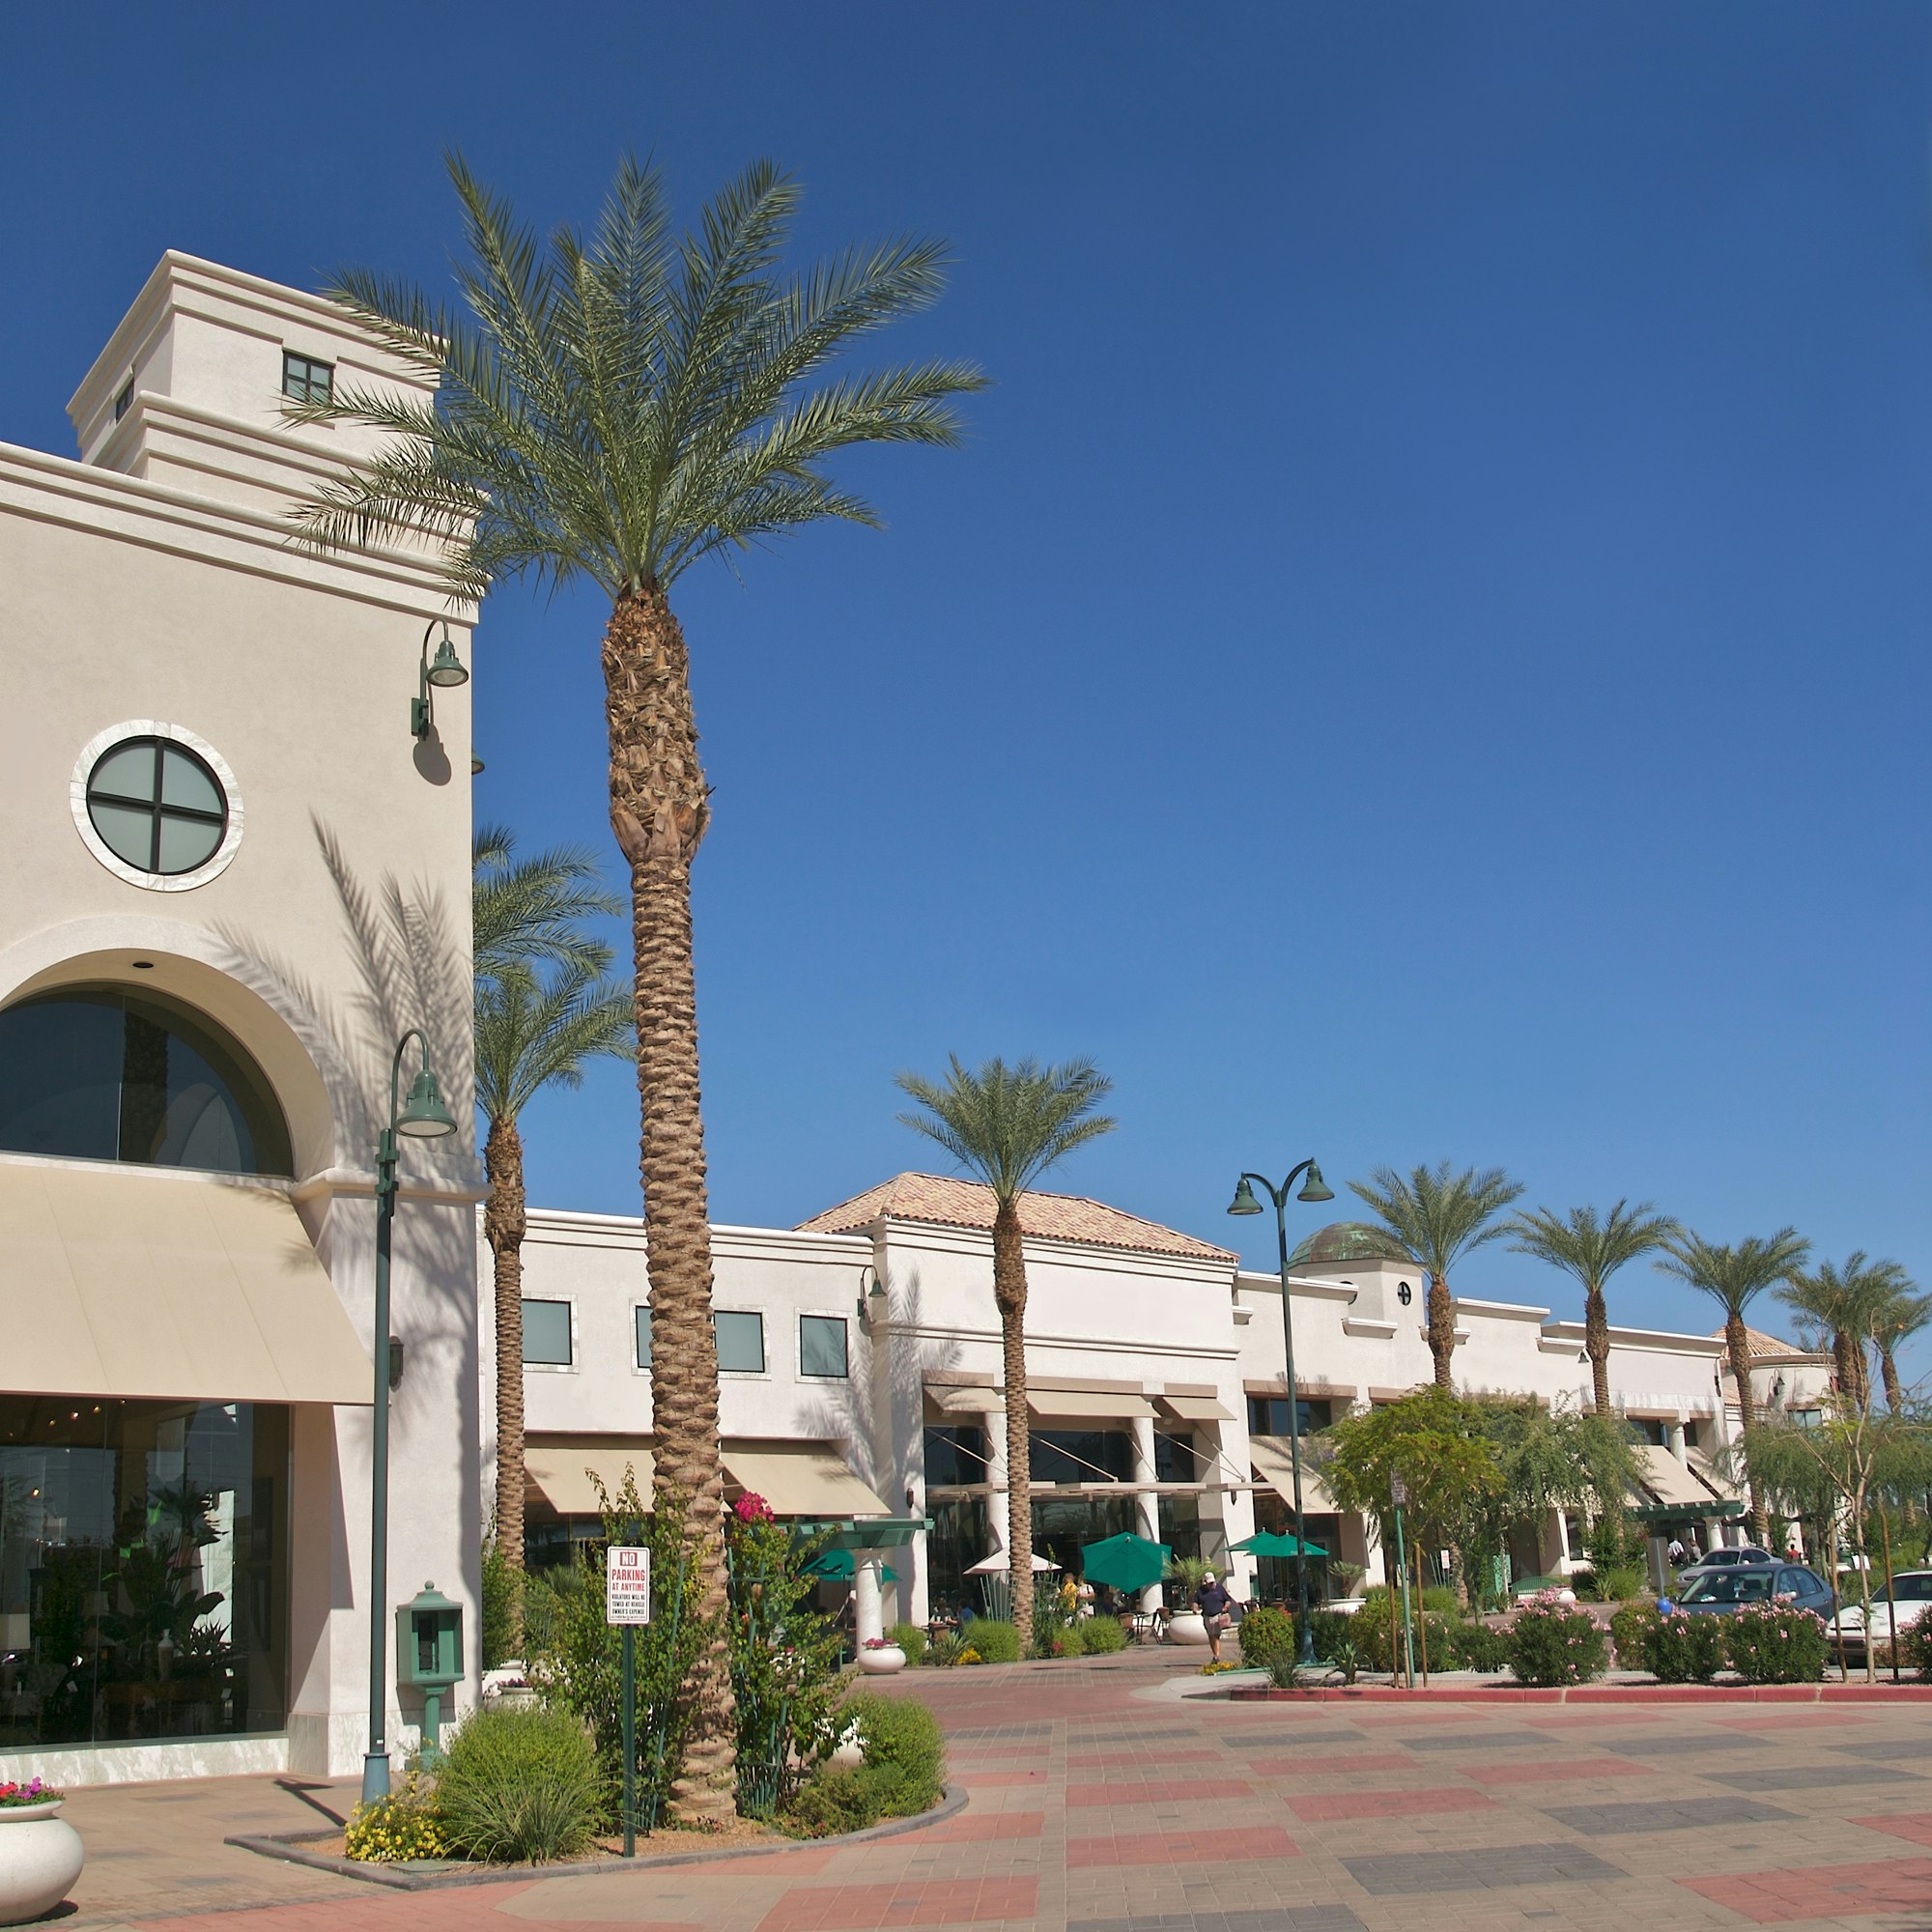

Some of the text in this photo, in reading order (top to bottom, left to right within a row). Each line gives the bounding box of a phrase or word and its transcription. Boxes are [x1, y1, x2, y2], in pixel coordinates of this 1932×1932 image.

[622, 1552, 636, 1566] NO
[611, 1569, 645, 1580] PARKING
[611, 1582, 644, 1591] AT ANYTIME
